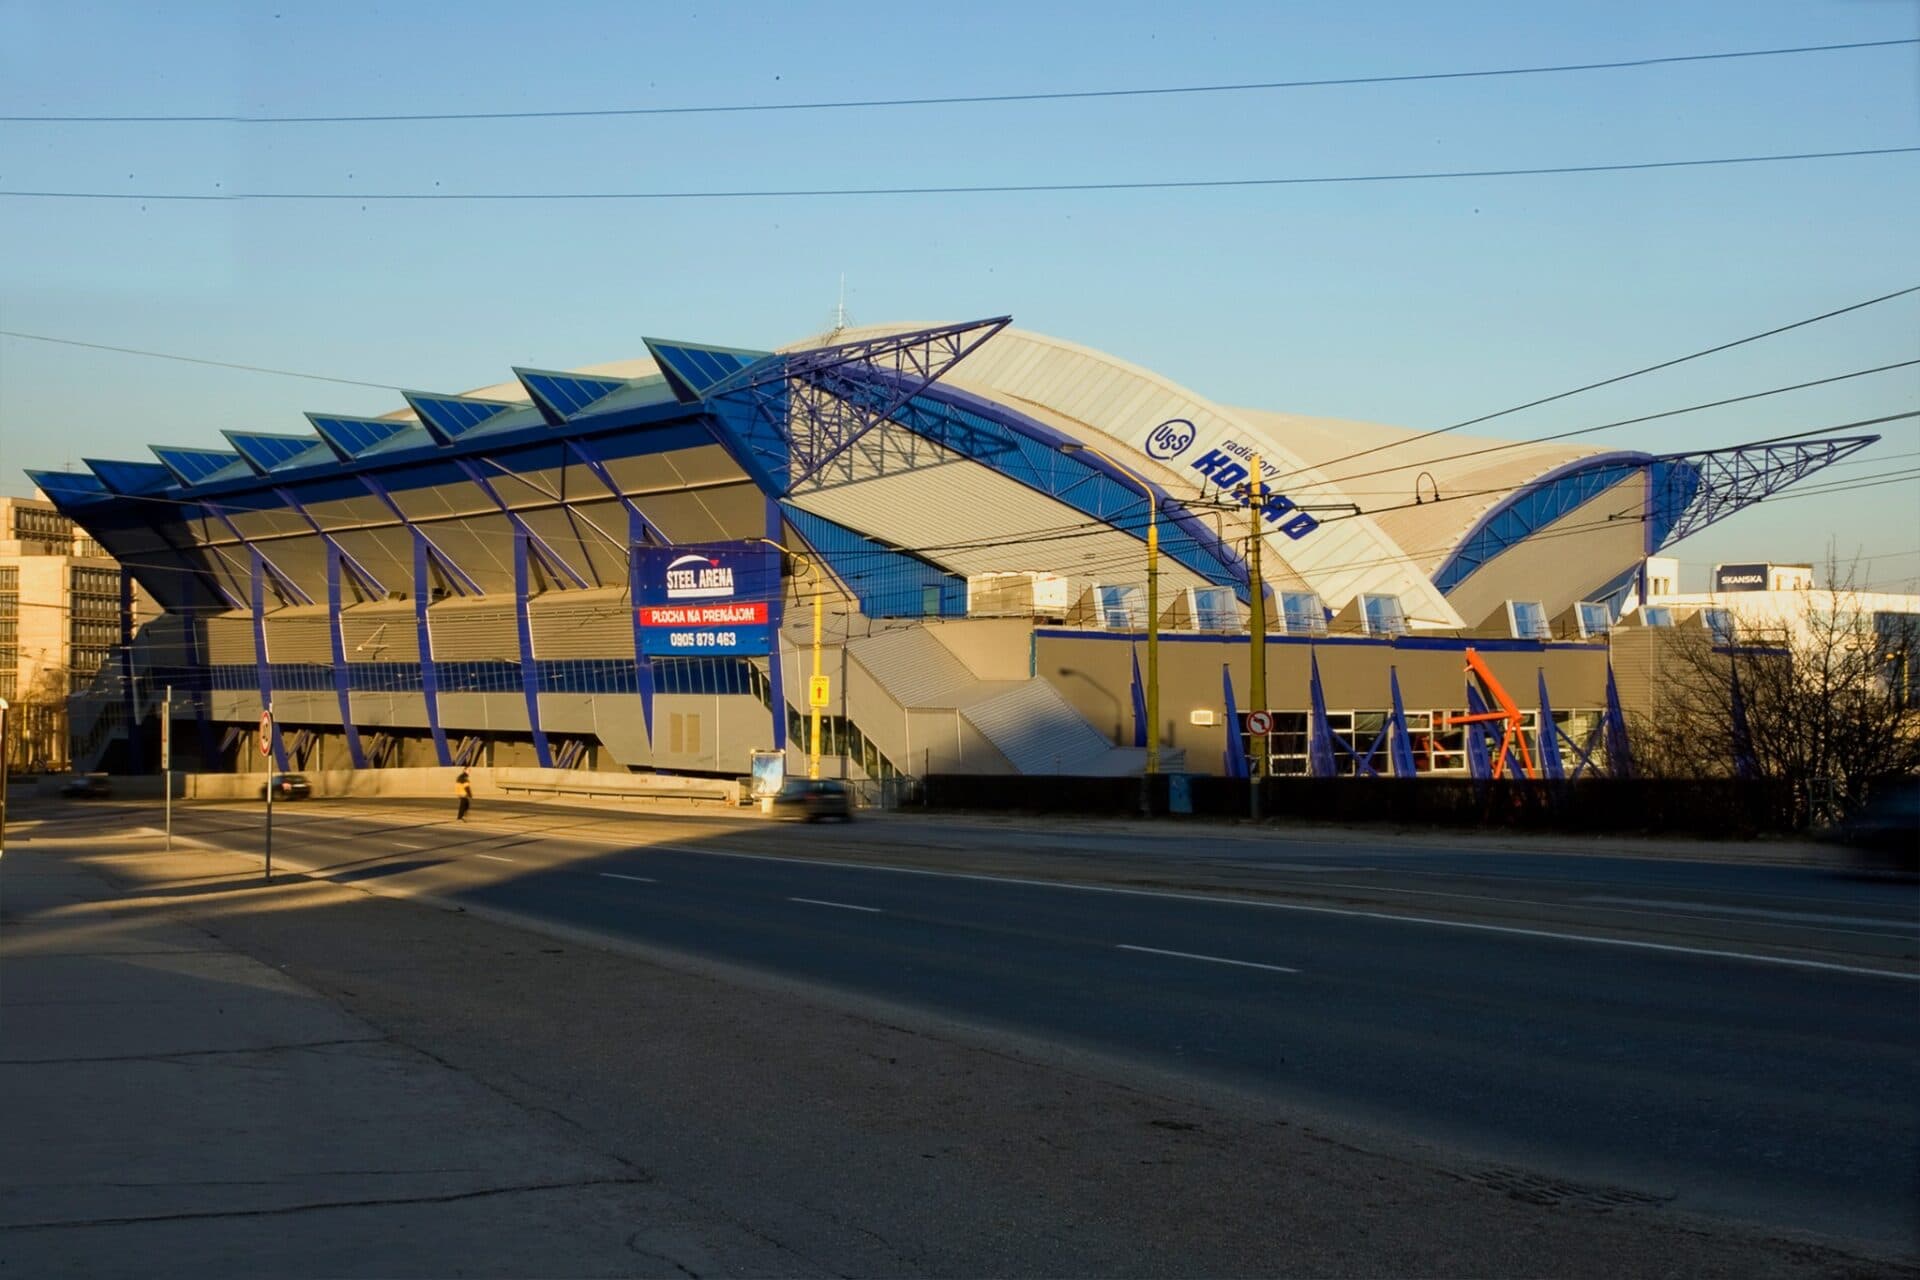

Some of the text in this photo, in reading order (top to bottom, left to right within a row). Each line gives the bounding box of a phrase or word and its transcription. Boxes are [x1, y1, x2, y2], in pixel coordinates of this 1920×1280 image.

[1154, 426, 1190, 452] USS
[1221, 439, 1281, 477] radiáory
[667, 568, 733, 589] STEEL ARENA
[1721, 575, 1762, 584] SKANSKA
[652, 606, 755, 623] PLOCHA NA PRENÁJOM
[670, 633, 694, 646] 0905
